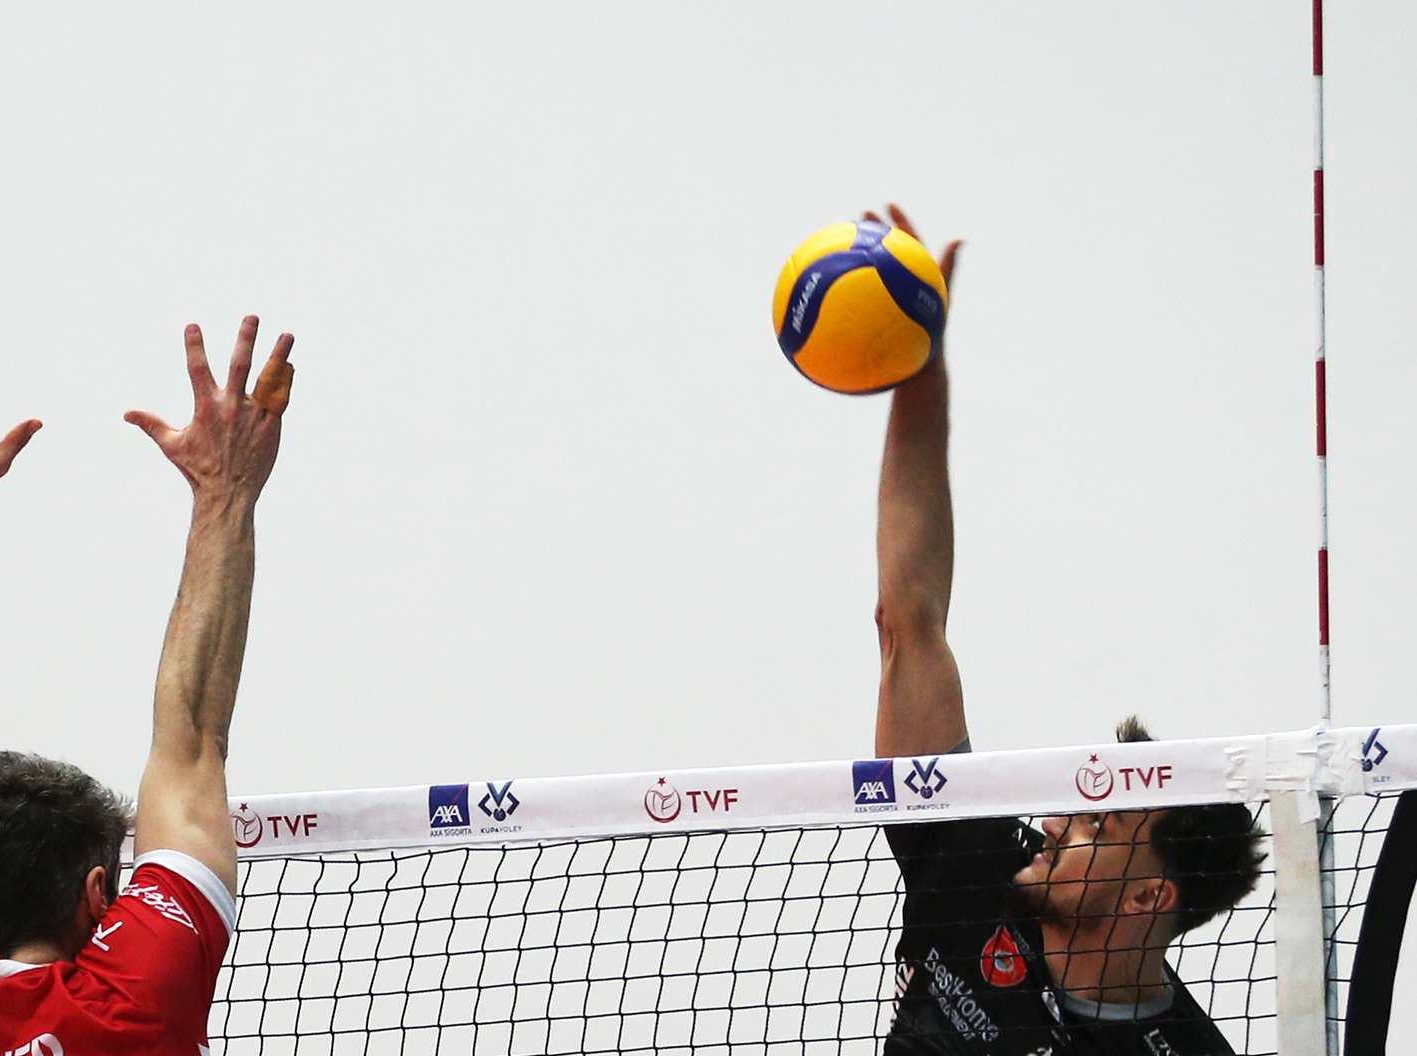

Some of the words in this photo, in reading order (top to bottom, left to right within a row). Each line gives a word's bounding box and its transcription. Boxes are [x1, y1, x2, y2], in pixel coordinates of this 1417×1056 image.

[1118, 766, 1173, 792] TVF
[686, 789, 738, 813] TVF
[854, 781, 889, 801] AXA
[430, 804, 463, 824] AXA
[267, 813, 318, 838] TVF
[480, 825, 522, 834] KUPAVOLEY
